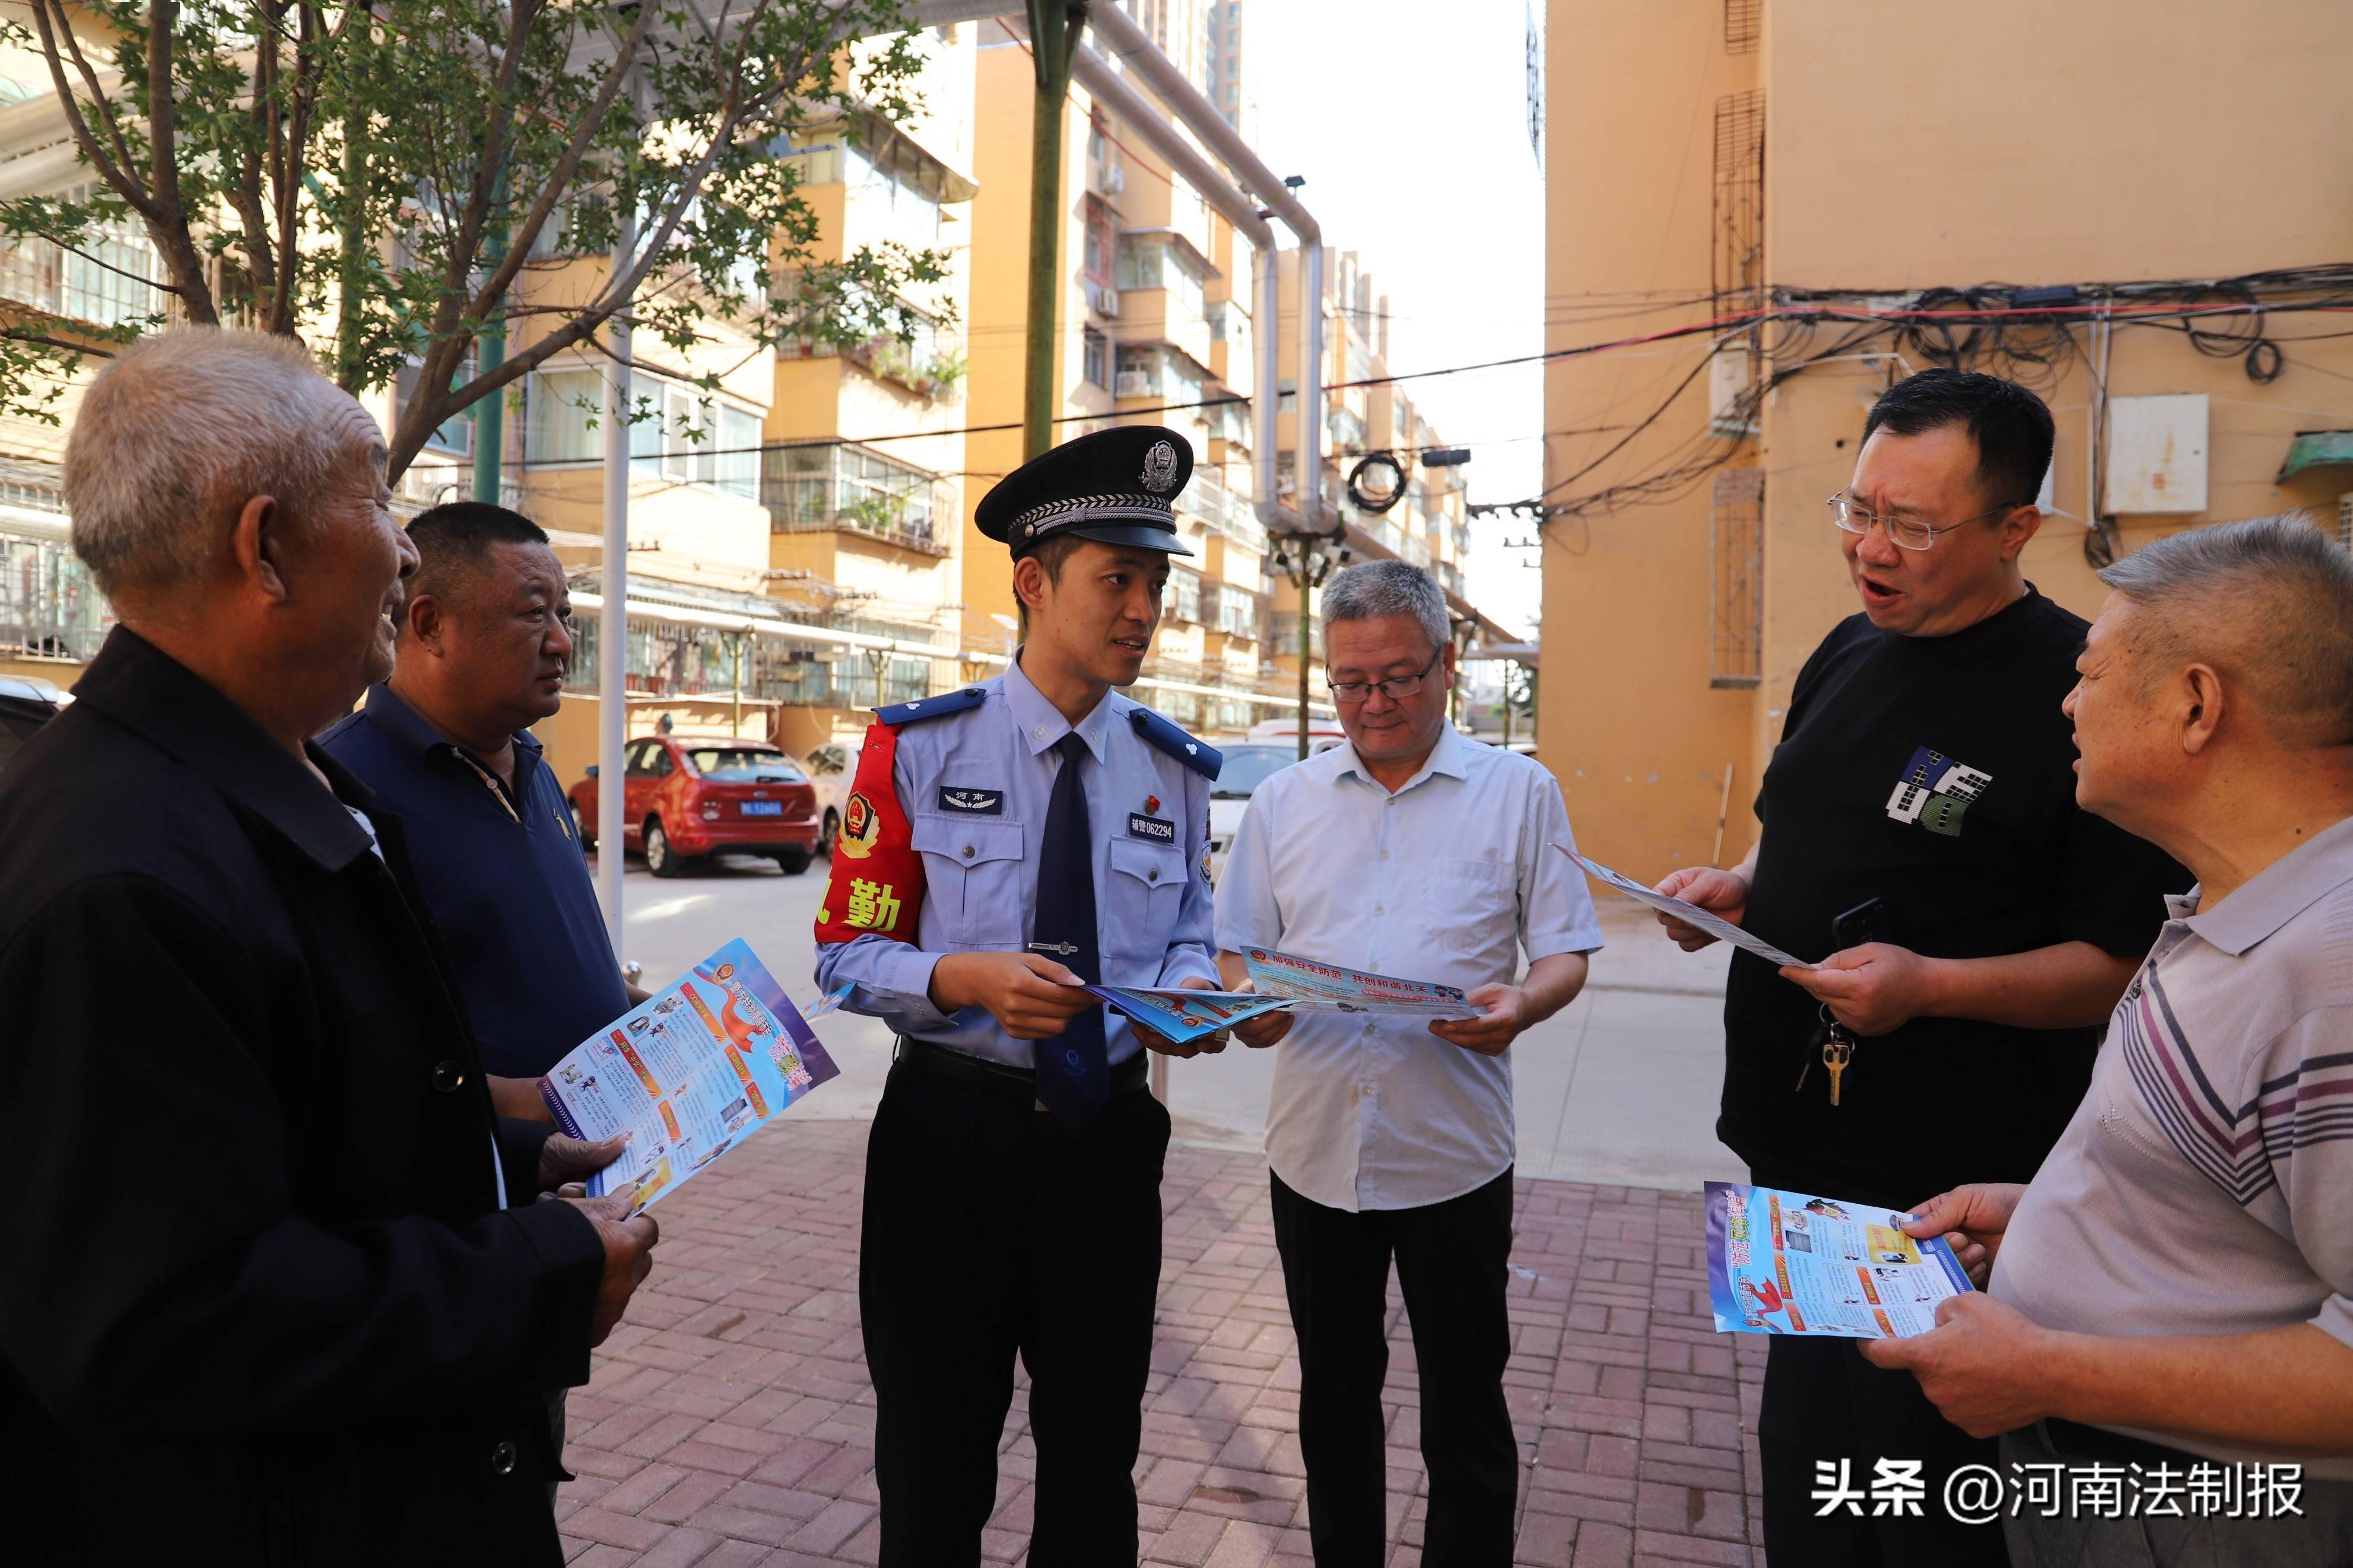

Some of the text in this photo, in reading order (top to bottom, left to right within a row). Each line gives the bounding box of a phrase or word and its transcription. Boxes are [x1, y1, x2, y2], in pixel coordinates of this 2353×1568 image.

[955, 791, 985, 801] 河南
[1132, 818, 1172, 838] 辅警062294
[1272, 955, 1342, 979] 加强安全防范
[1352, 974, 1428, 993] 共创和谐北关
